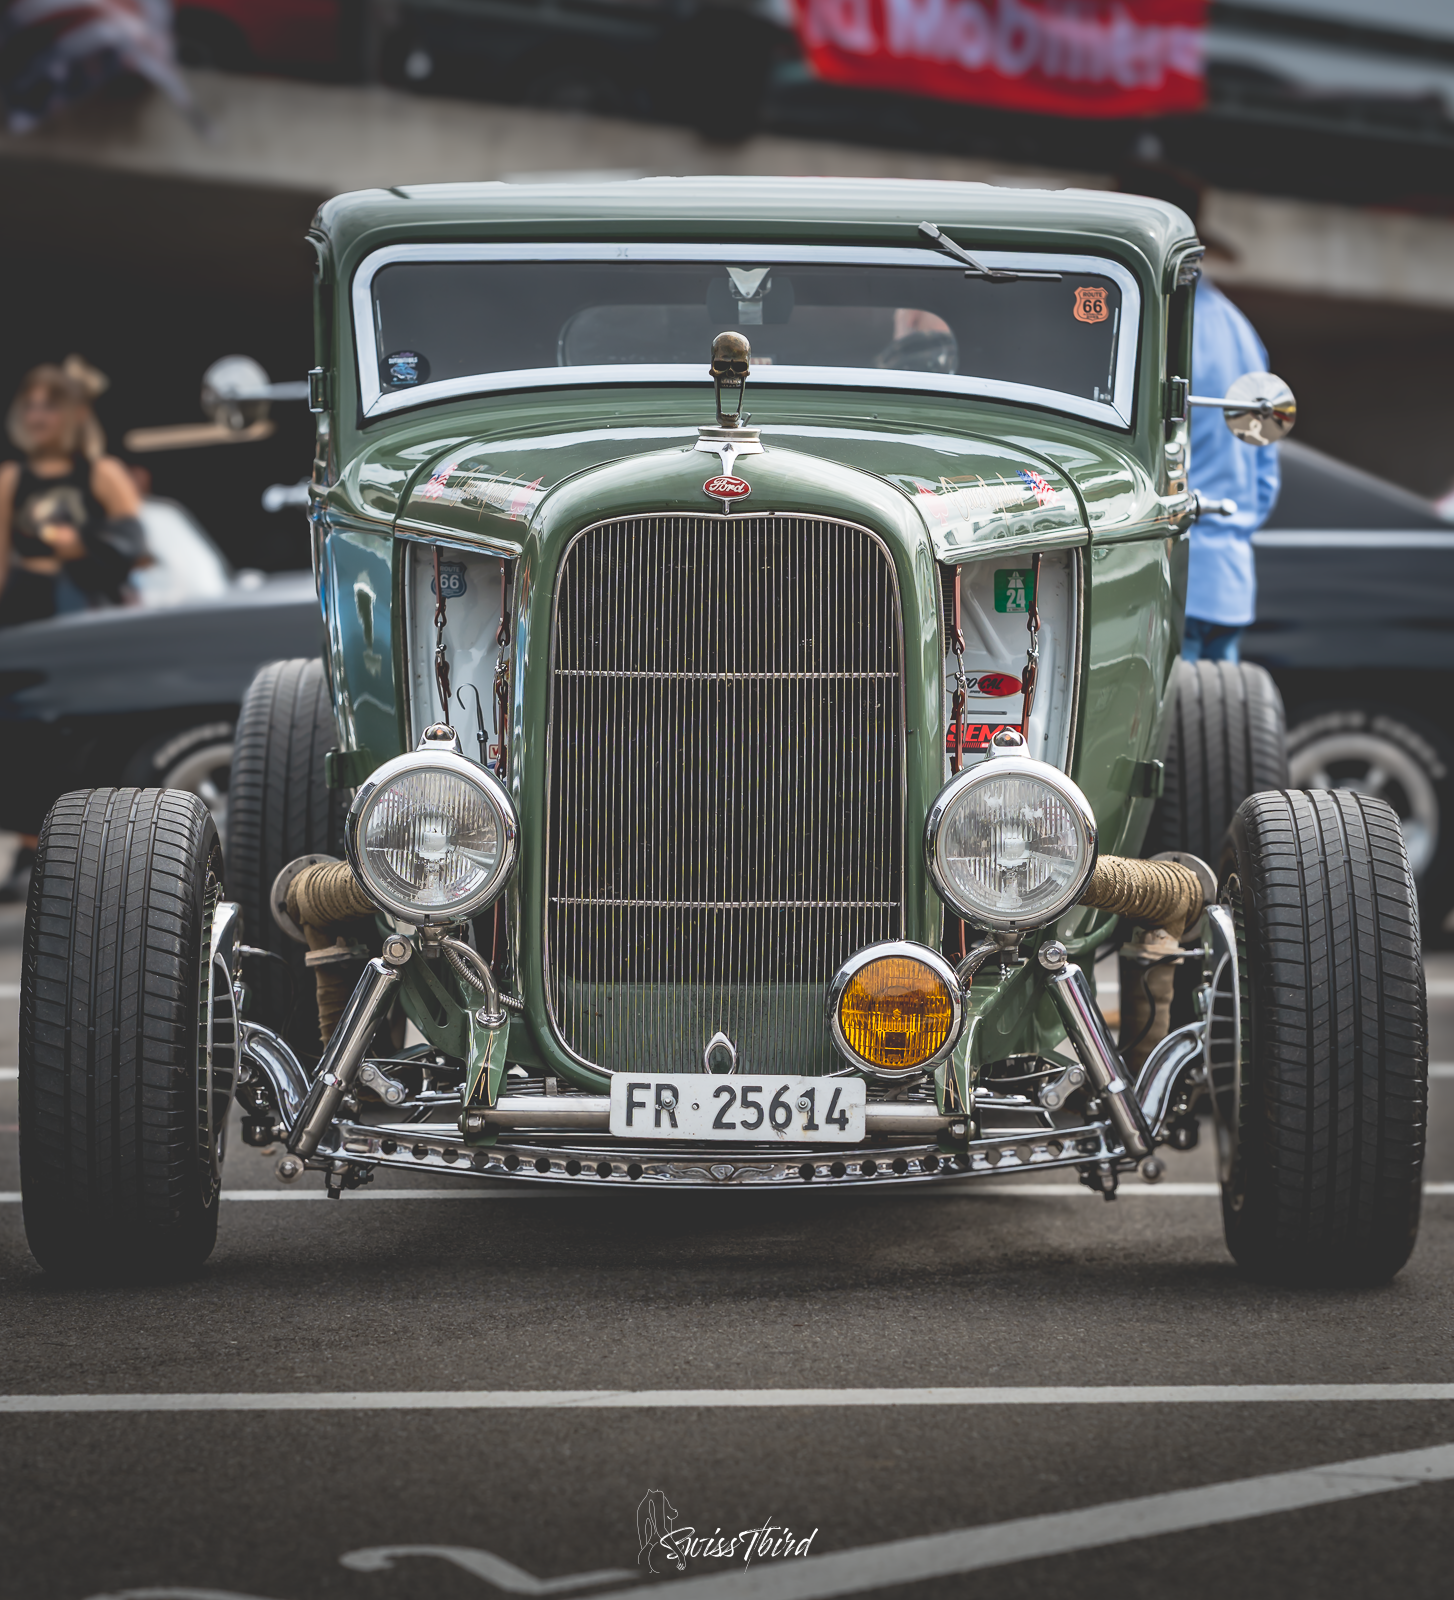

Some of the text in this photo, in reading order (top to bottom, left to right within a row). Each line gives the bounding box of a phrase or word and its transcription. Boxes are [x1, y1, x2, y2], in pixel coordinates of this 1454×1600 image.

[1083, 299, 1103, 314] 66
[709, 477, 745, 493] Ford
[440, 573, 460, 589] 66
[1006, 588, 1026, 608] 24
[625, 1082, 679, 1128] FR
[712, 1084, 850, 1131] 25614
